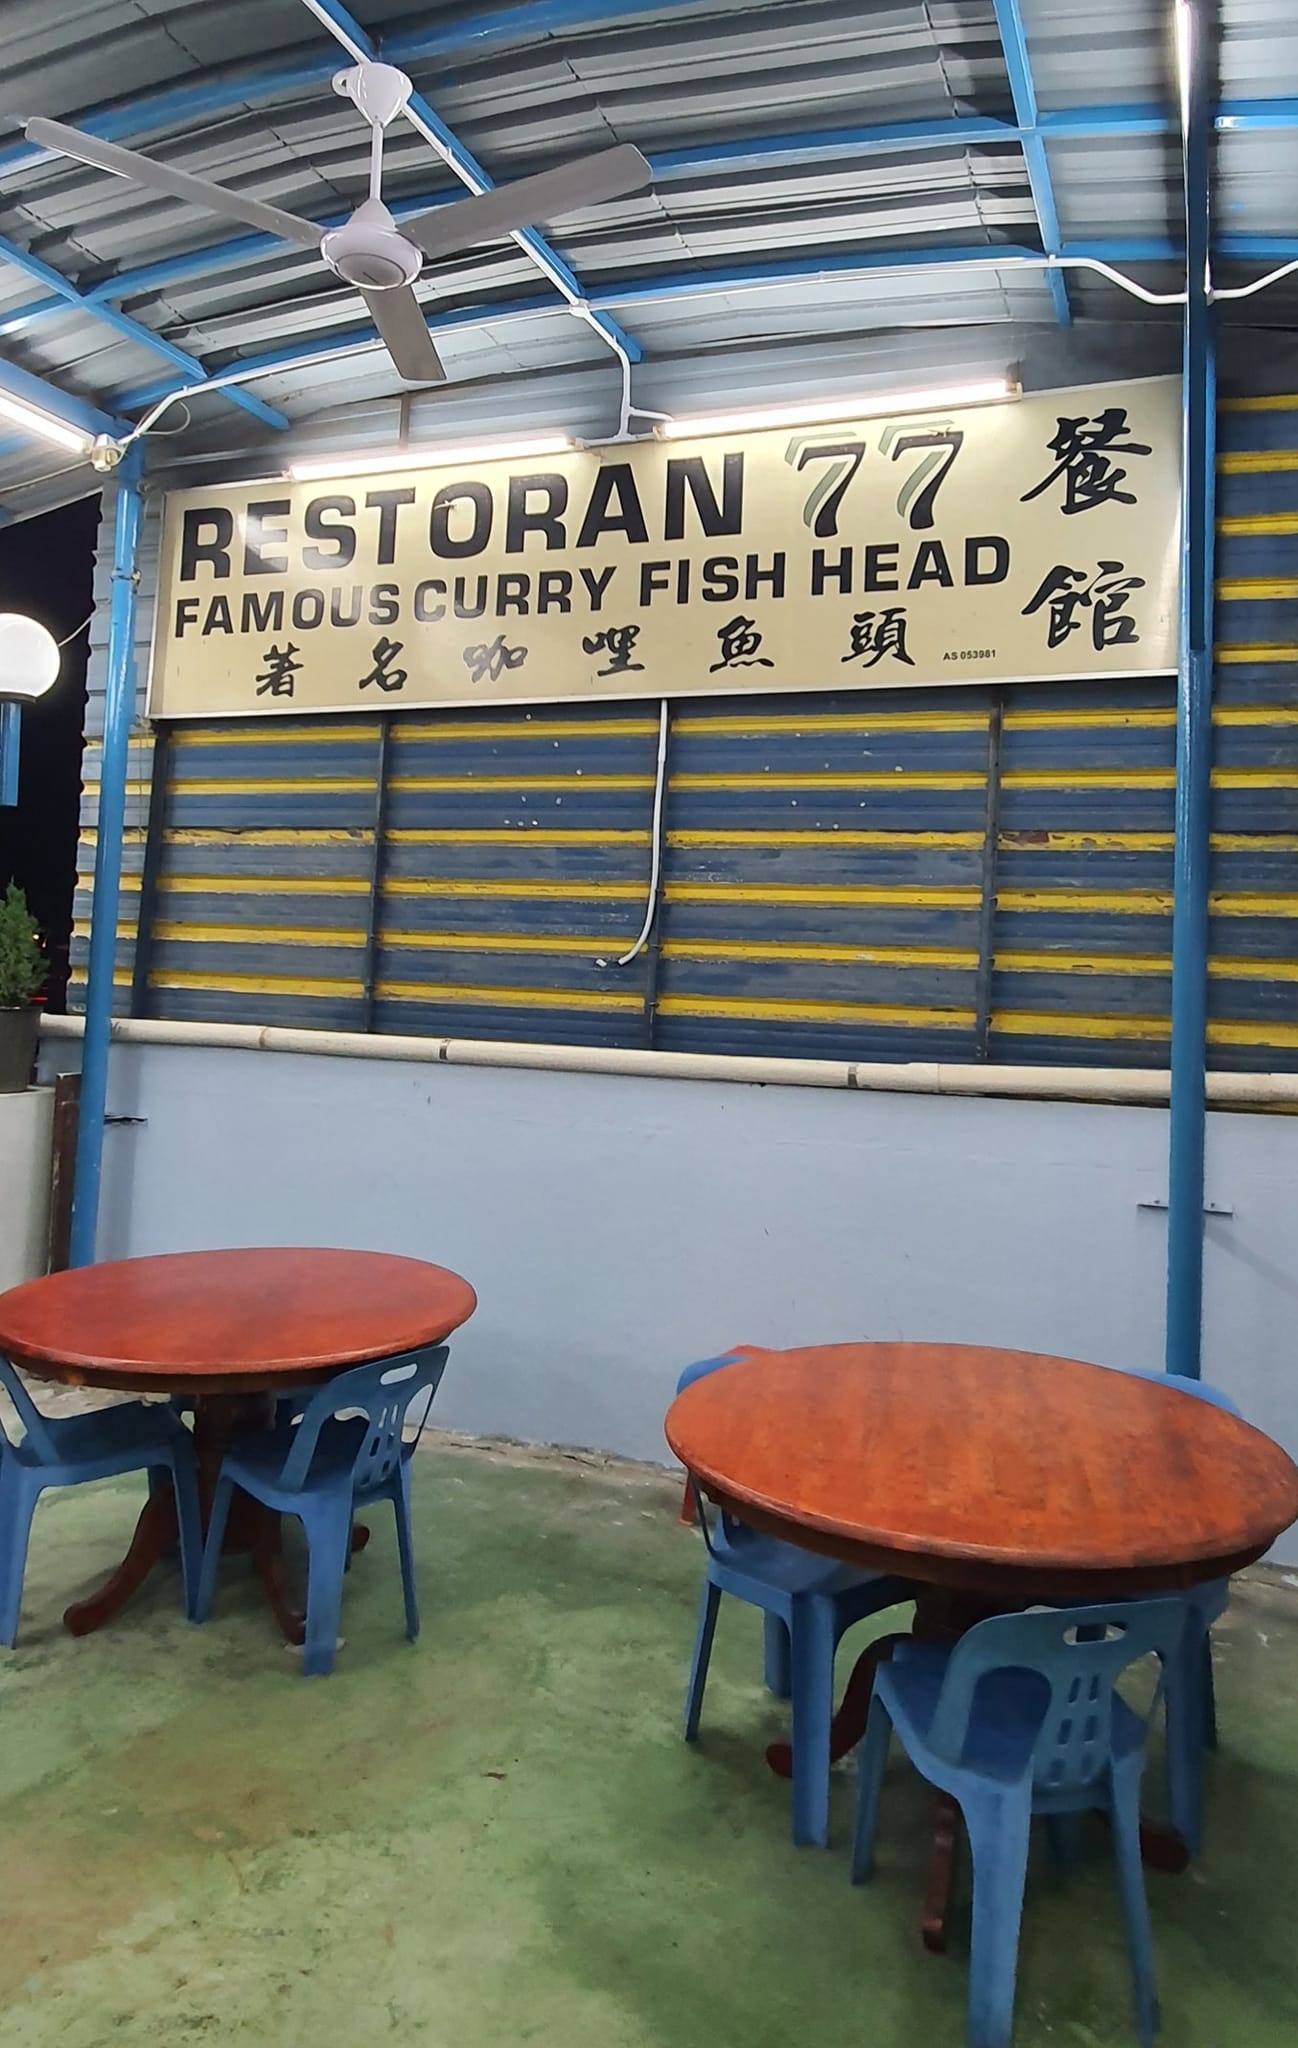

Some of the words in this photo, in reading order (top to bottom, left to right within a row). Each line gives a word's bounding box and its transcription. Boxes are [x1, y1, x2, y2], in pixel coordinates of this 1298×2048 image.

[180, 452, 744, 581] RESTORAN
[785, 420, 964, 538] 77
[1021, 408, 1152, 651] 餐館
[175, 584, 400, 638] FAMOUS
[413, 566, 617, 622] CURRY
[640, 552, 786, 606] FISH
[811, 536, 1011, 596] HEAD
[943, 652, 958, 661] AS
[960, 649, 996, 660] 053981
